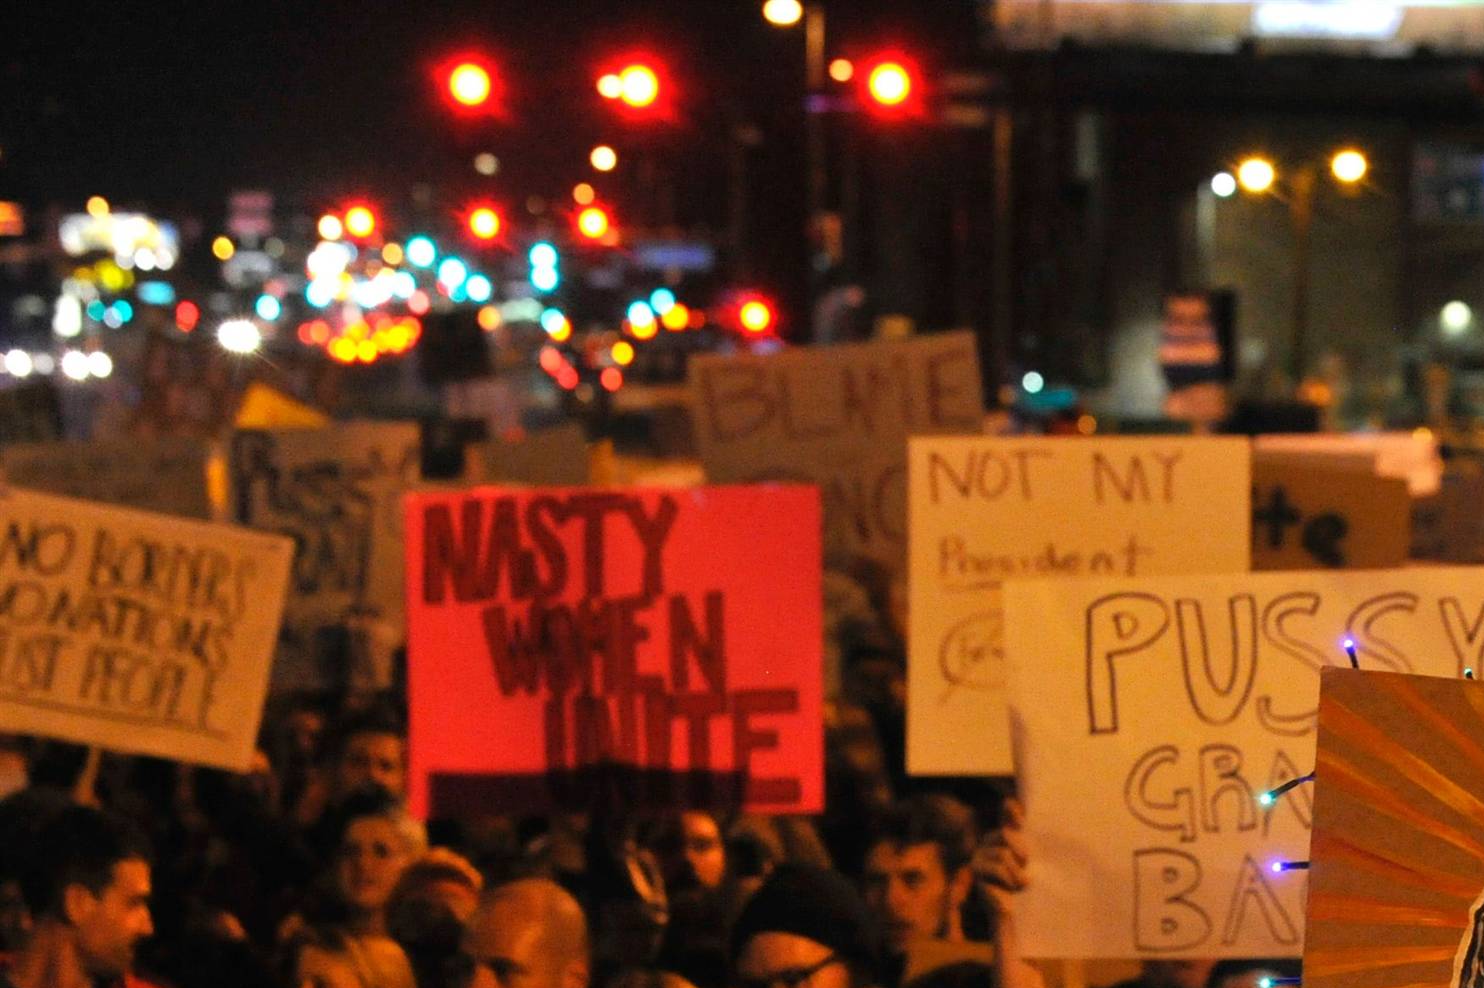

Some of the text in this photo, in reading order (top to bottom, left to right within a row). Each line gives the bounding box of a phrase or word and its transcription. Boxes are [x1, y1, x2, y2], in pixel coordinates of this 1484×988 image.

[929, 449, 1183, 506] NOT MY
[424, 494, 678, 606] NASTY
[938, 535, 1153, 580] President
[481, 589, 727, 698] WOMEN
[543, 688, 802, 806] UNITE
[1132, 846, 1308, 953] BA
